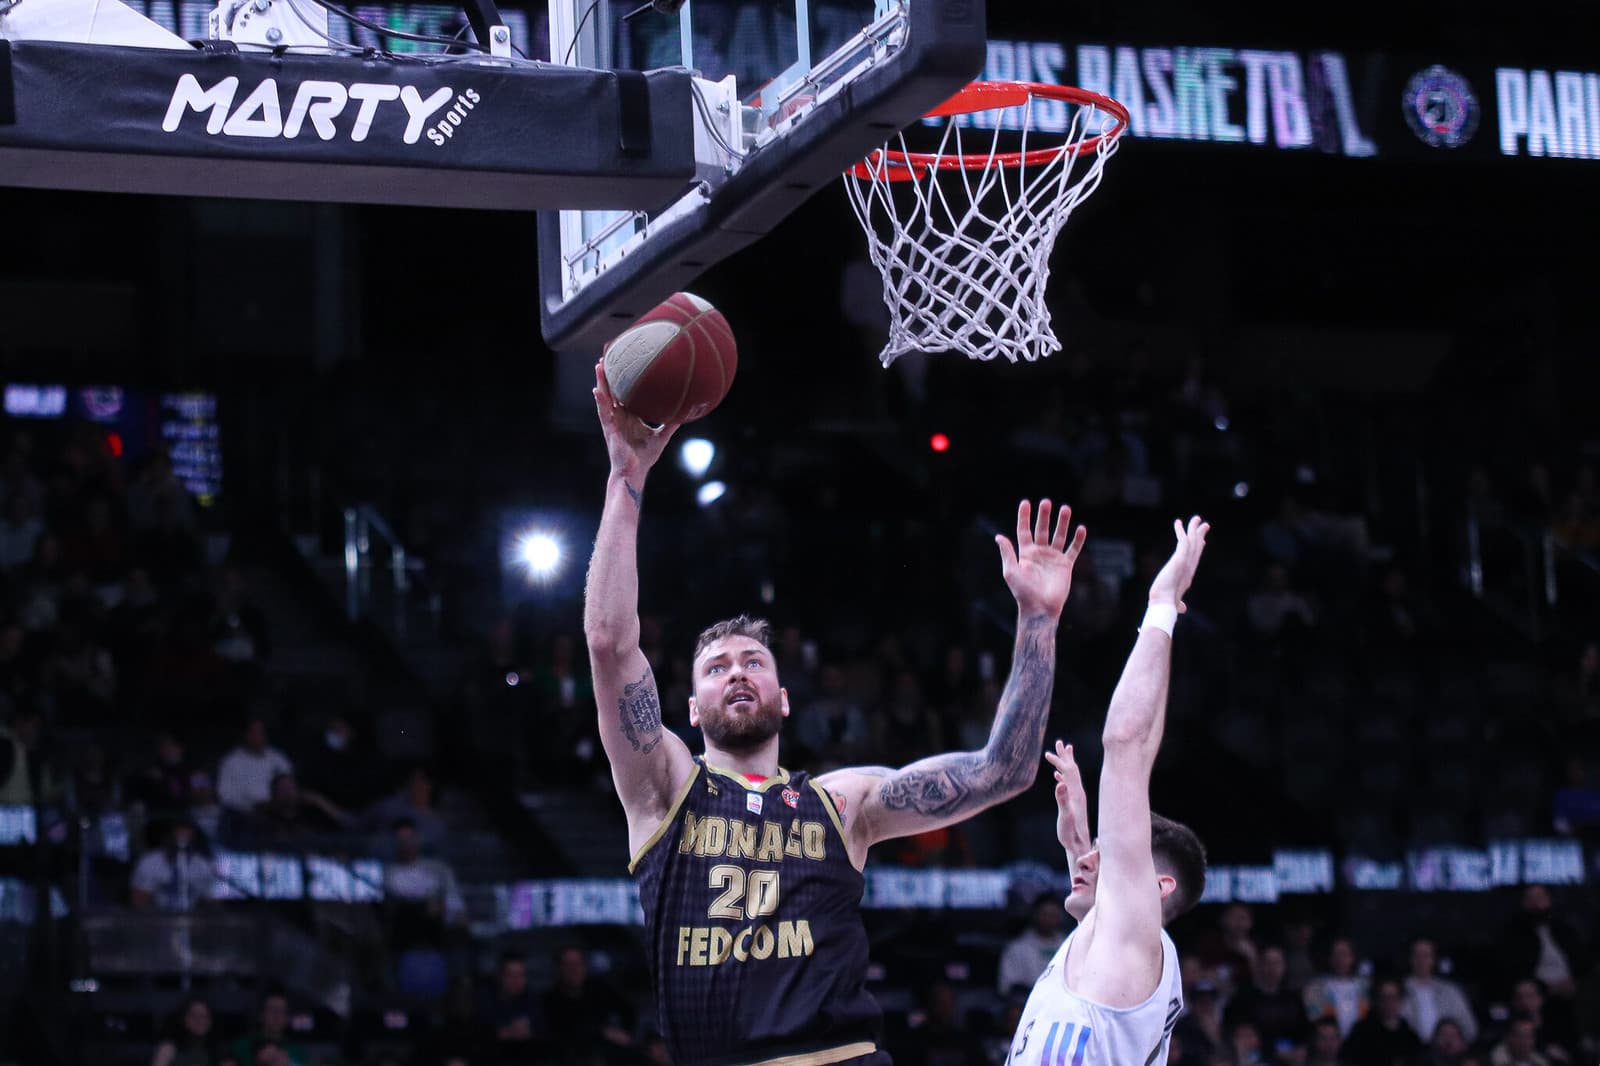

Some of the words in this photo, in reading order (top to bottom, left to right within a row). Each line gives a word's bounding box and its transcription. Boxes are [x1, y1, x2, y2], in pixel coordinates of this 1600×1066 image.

[163, 73, 453, 145] MARTY
[679, 811, 826, 862] MONACO
[708, 865, 780, 920] 20
[677, 920, 814, 966] FEDCOM
